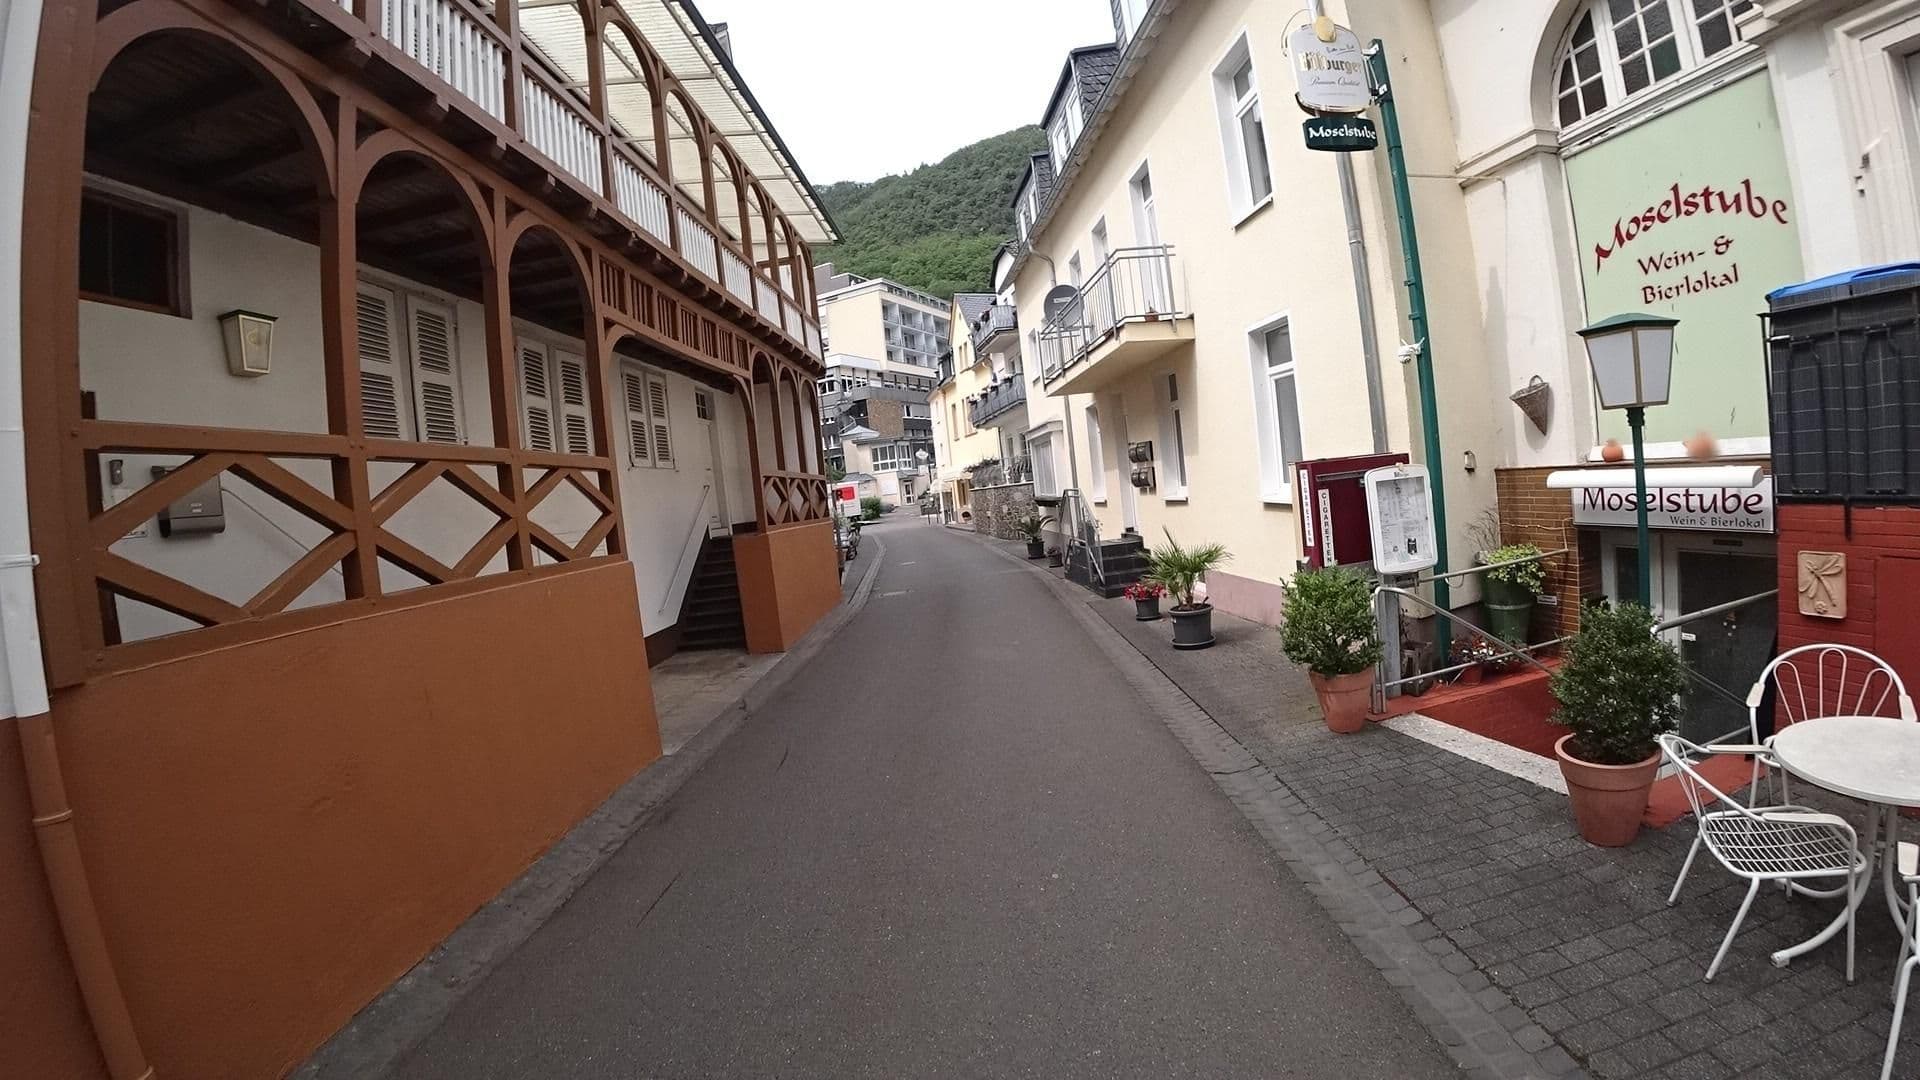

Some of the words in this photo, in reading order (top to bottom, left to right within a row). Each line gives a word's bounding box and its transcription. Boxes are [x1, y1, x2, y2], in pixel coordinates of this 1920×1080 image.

[1308, 124, 1376, 140] Moselstube
[1595, 178, 1789, 276] Moselstube
[1637, 251, 1705, 276] Wein-
[1713, 235, 1734, 256] &
[1641, 263, 1740, 304] Bierlokal
[1582, 487, 1764, 515] Moselstube
[1320, 492, 1333, 563] CIGARETTEN
[1669, 515, 1697, 526] Wein
[1699, 516, 1706, 527] &
[1711, 516, 1765, 529] Bierlokal
